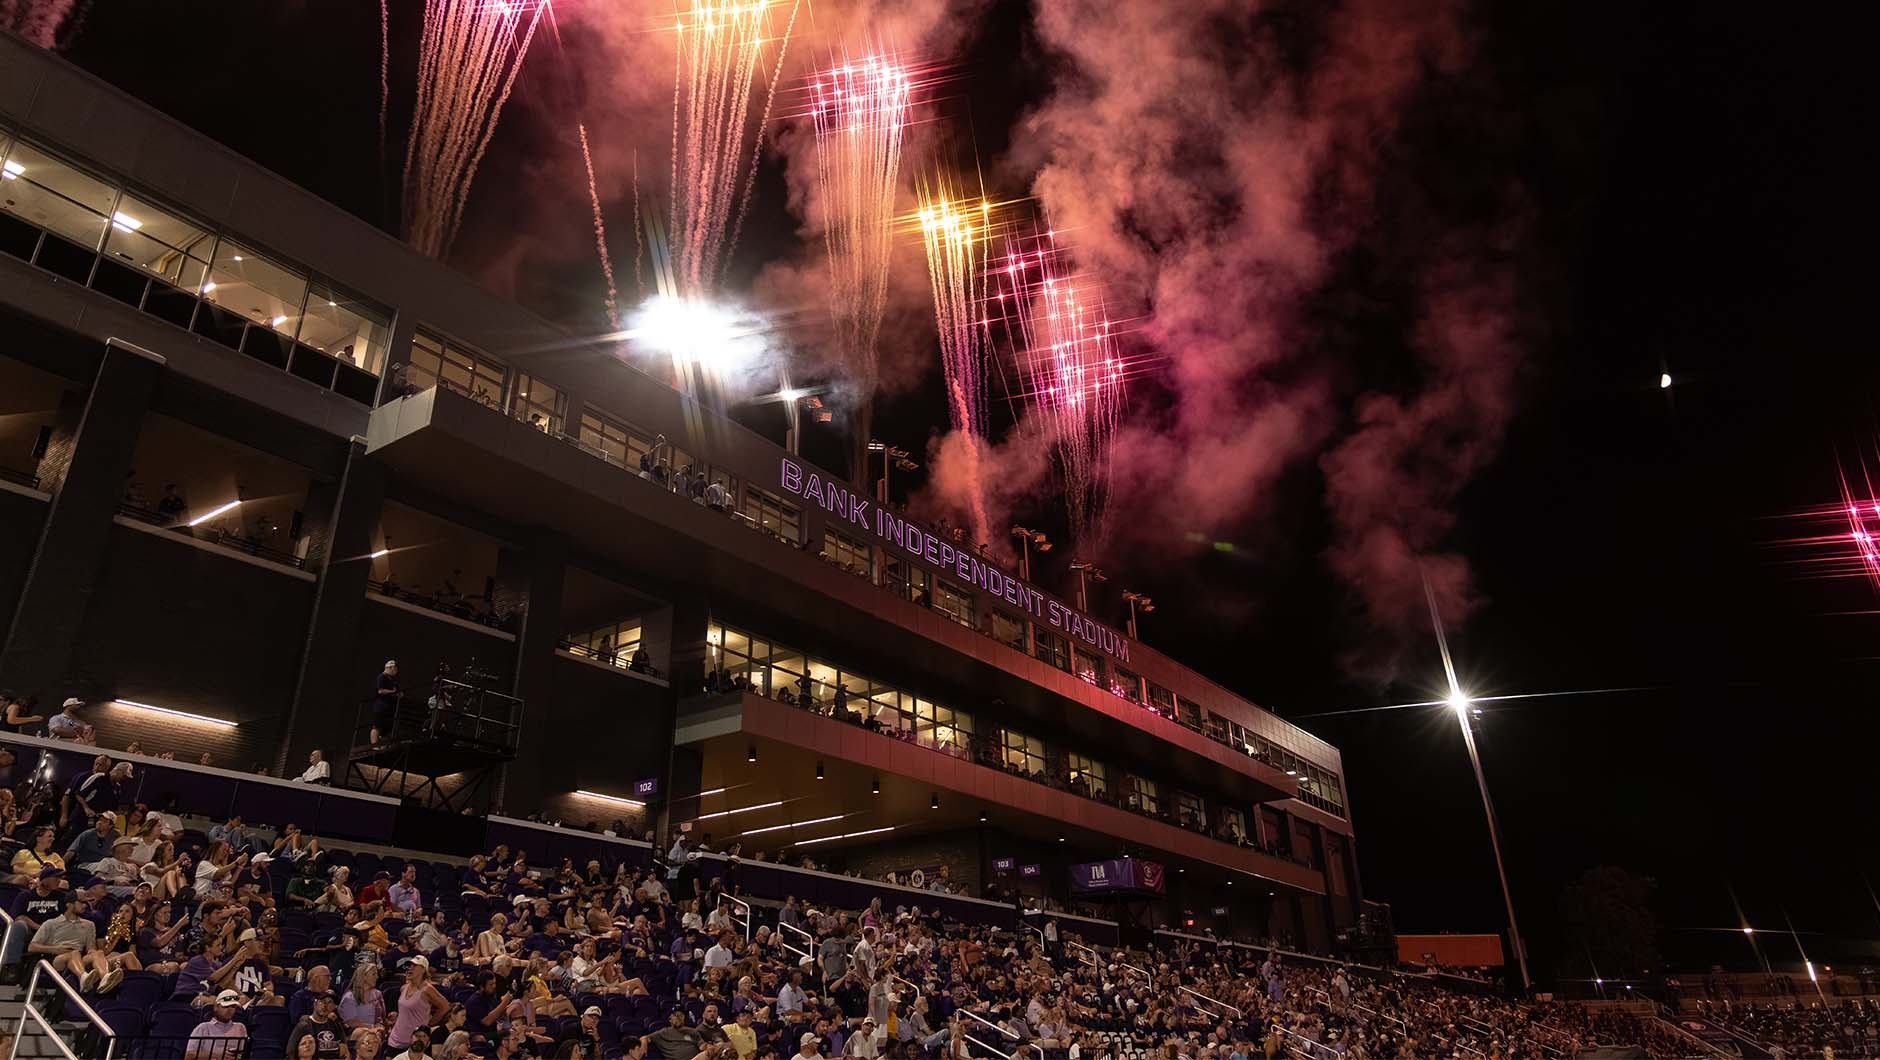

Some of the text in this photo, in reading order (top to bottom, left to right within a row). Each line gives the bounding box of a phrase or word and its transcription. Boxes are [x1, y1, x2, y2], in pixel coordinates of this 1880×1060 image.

[781, 458, 1130, 663] BANK INDEPENDENT STADIUM
[639, 782, 652, 792] 102
[997, 860, 1009, 868] 103
[1024, 867, 1035, 875] 104
